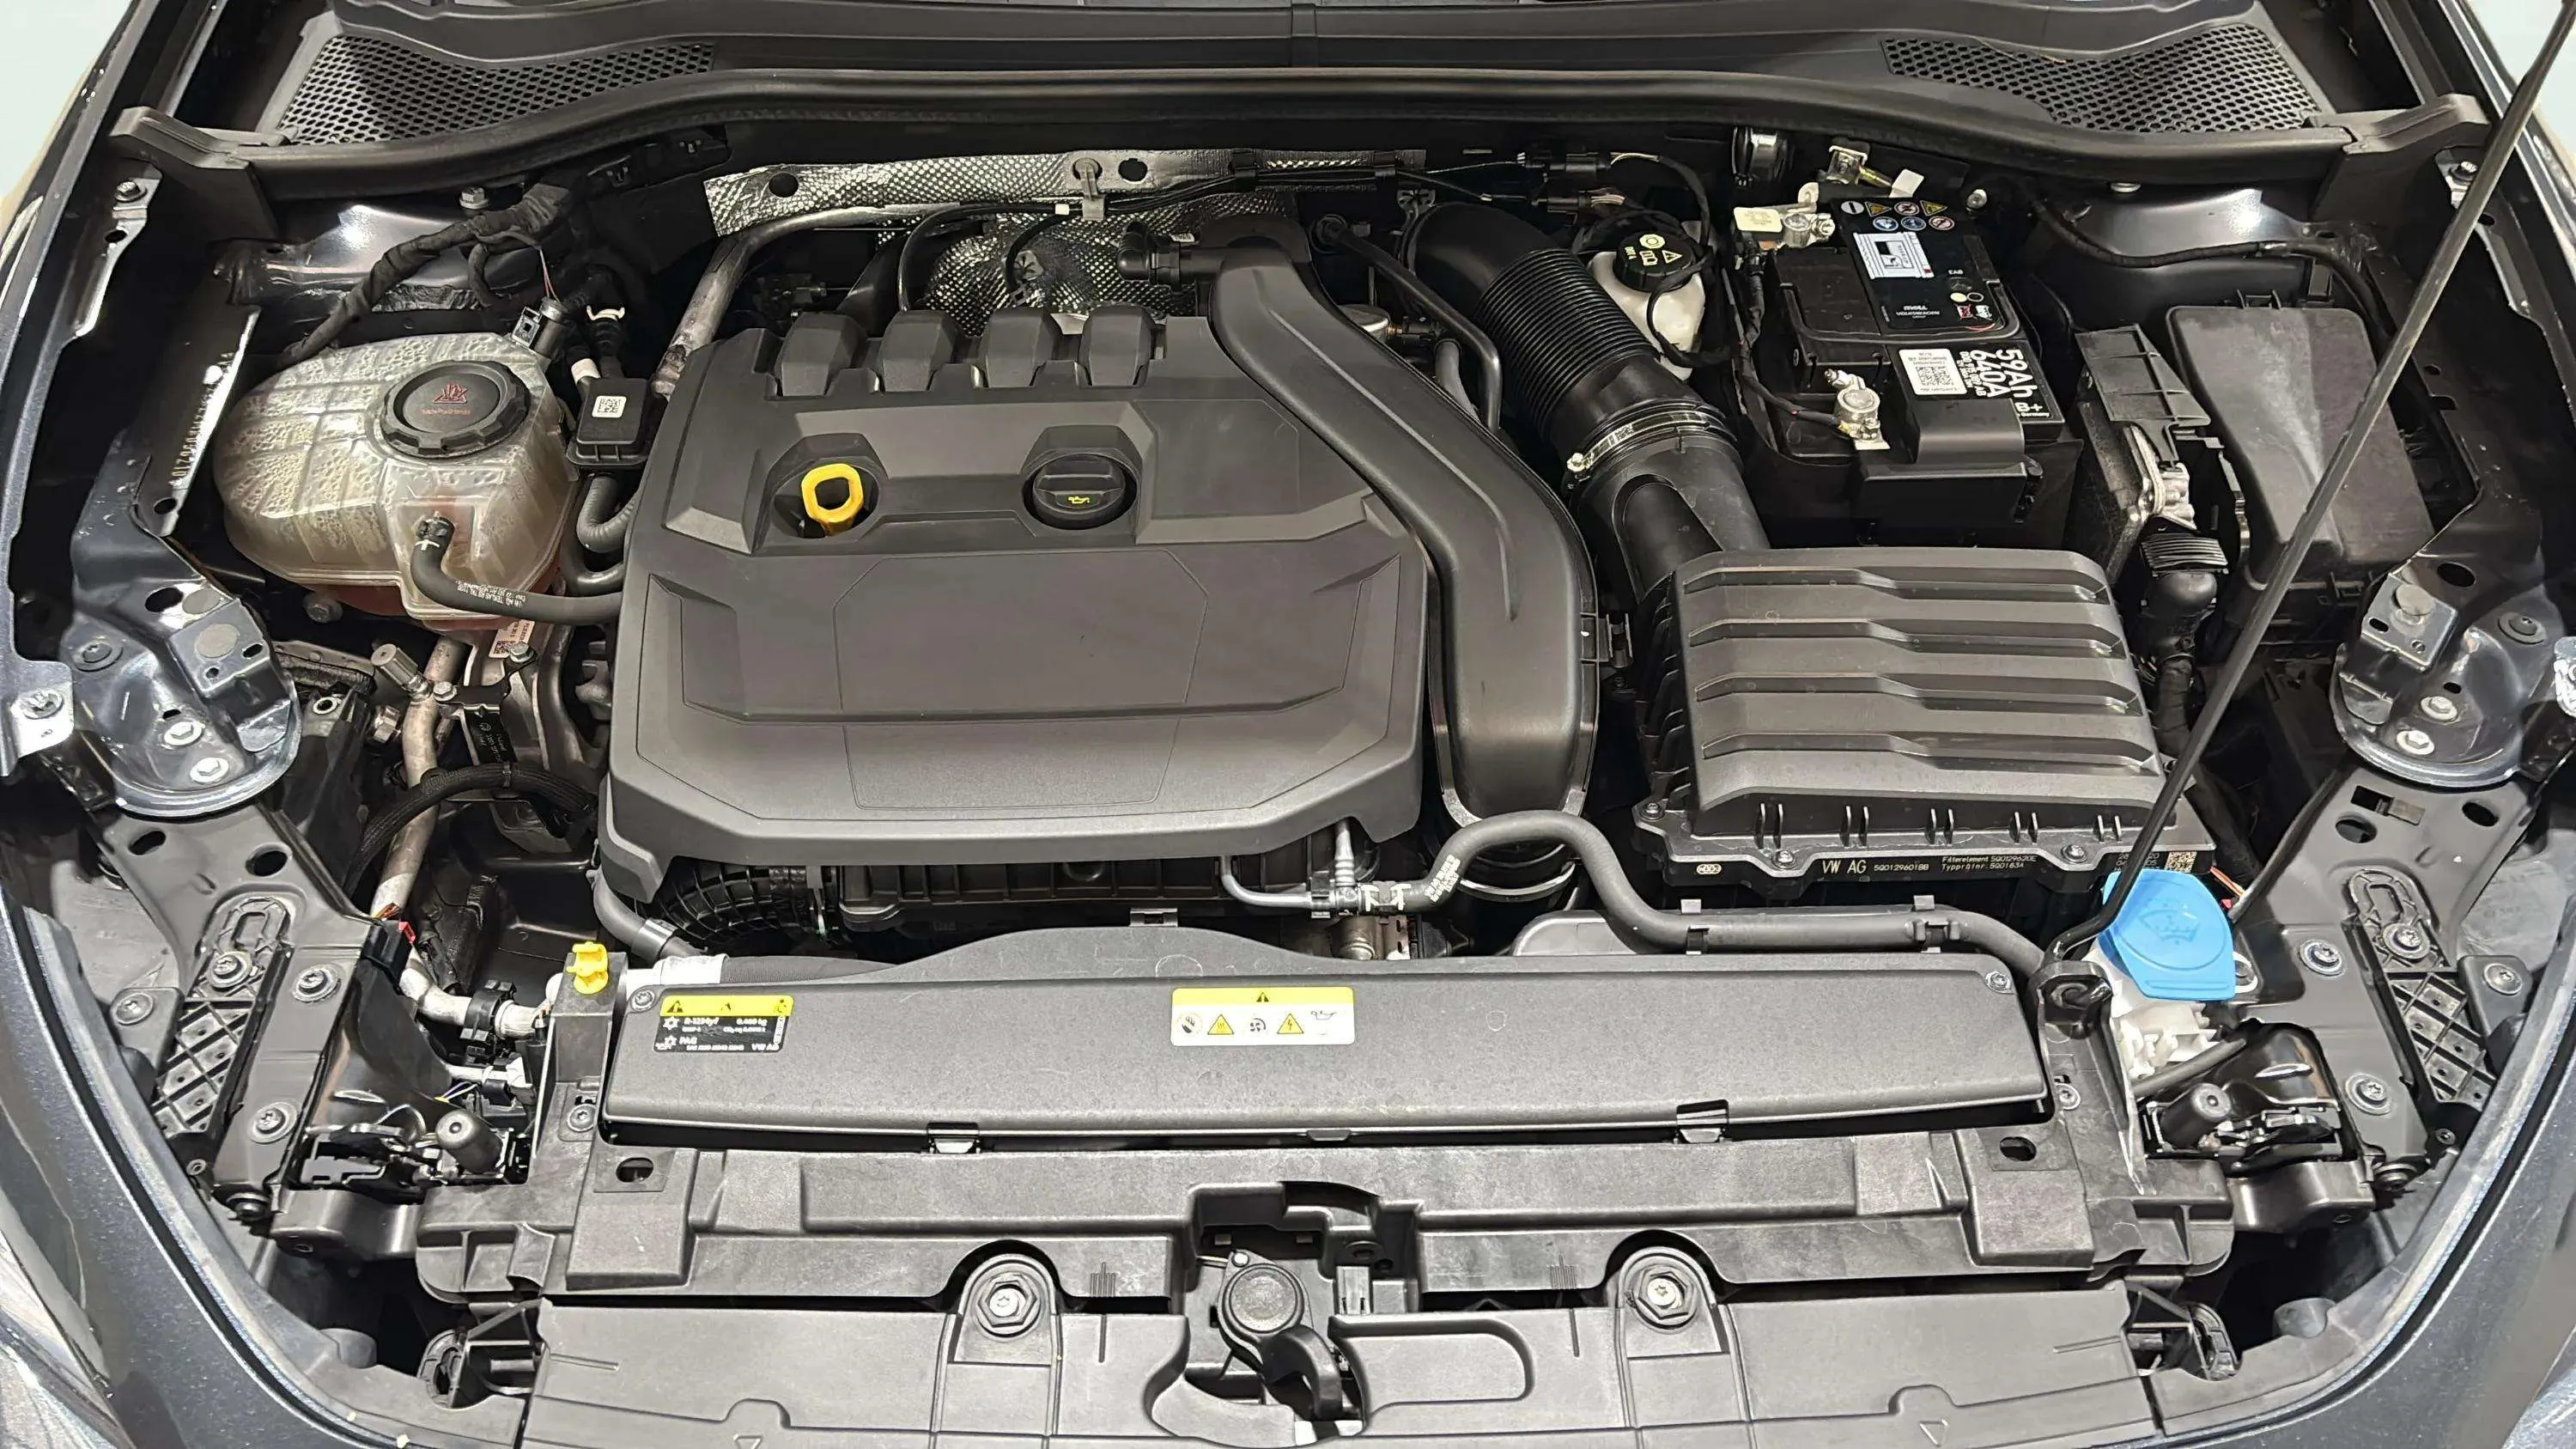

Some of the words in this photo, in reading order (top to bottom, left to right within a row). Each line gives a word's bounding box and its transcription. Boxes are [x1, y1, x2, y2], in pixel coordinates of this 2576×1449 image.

[1970, 350, 2012, 398] 640A
[1996, 349, 2038, 399] 59Ah
[1821, 859, 1842, 874] VW
[1847, 859, 1867, 874] AG
